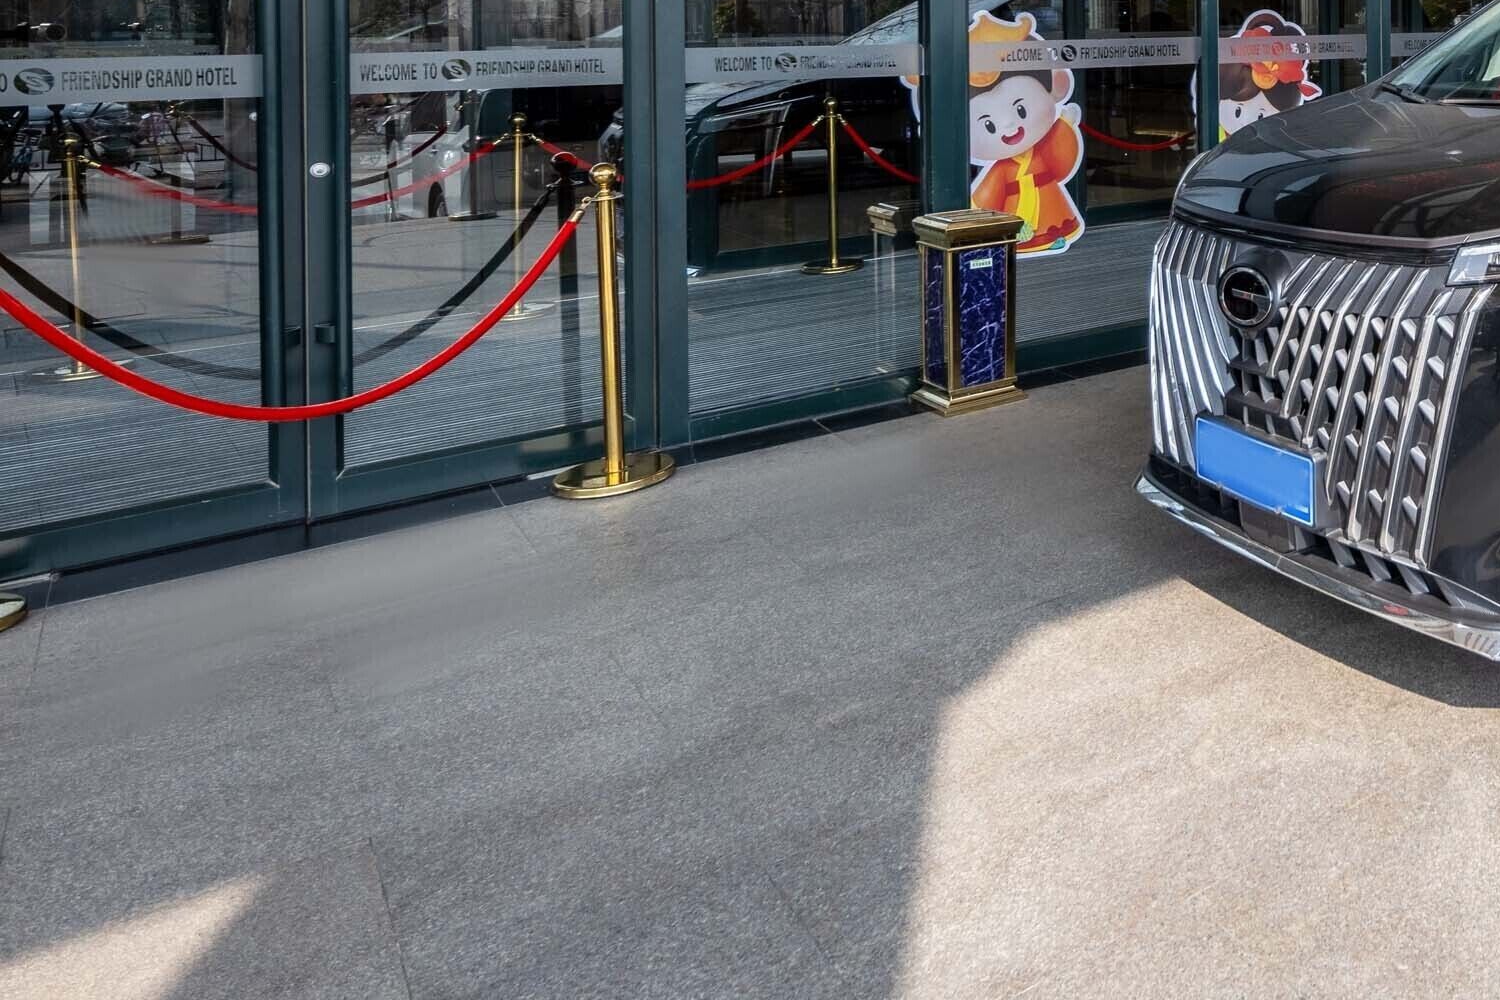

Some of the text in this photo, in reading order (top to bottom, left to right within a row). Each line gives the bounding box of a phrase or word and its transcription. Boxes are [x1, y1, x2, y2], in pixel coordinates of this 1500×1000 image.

[1080, 46, 1127, 59] FRIENDSHIP
[1129, 45, 1156, 57] GRAND
[1157, 44, 1180, 56] HOTEL
[360, 59, 605, 81] WELCOME TO FRIENDSHIP GRAND HOTEL
[715, 56, 757, 72] WELCOME
[759, 56, 772, 71] TO
[61, 69, 142, 91] FRIENDSHIP
[146, 68, 192, 88] GRAND
[196, 67, 237, 86] HOTEL
